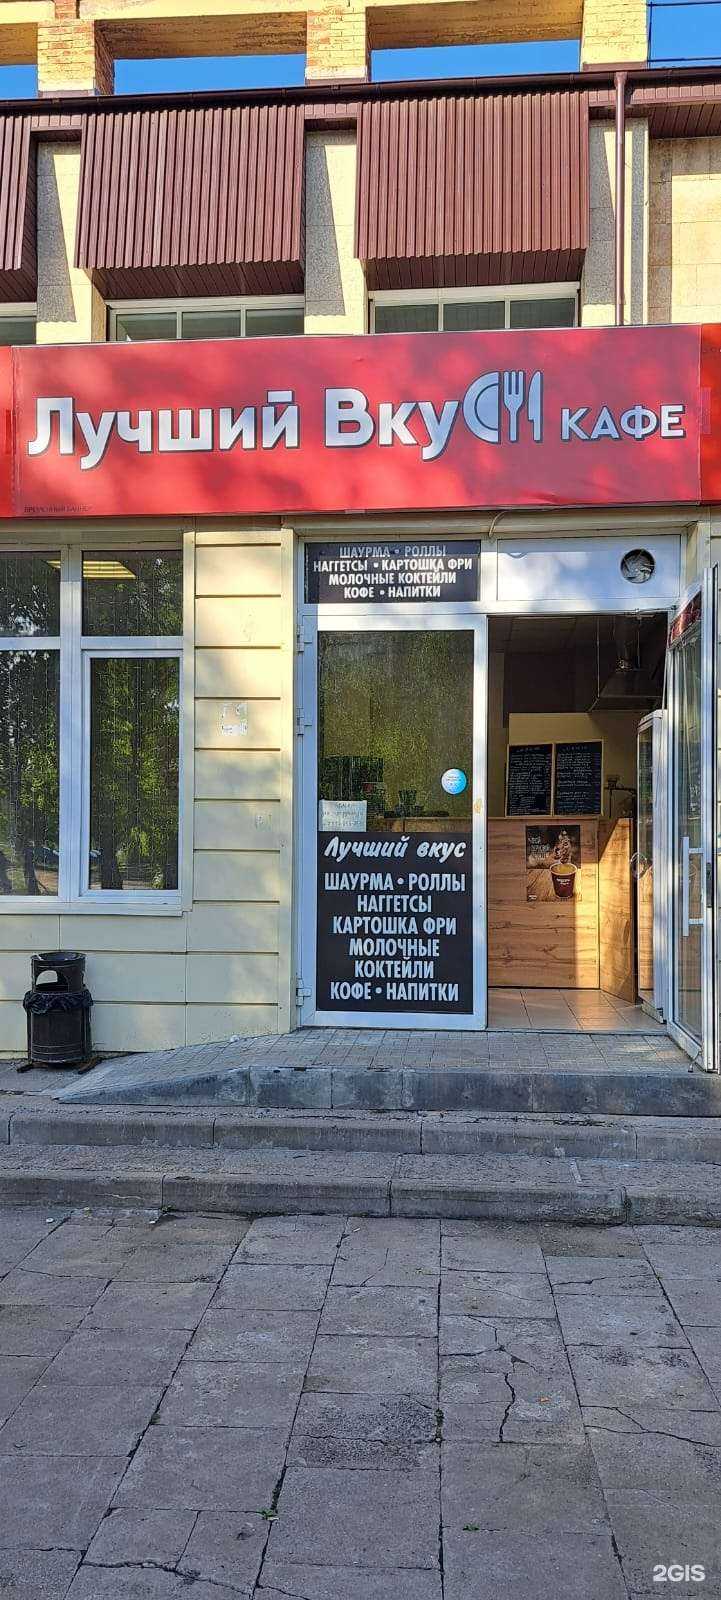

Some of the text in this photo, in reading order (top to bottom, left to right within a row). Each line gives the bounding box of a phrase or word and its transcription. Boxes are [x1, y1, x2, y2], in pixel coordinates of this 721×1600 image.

[27, 390, 301, 470] Лучший
[560, 403, 687, 442] КАФЕ
[339, 545, 446, 558] ШАУРМА РОЛЛЫ
[313, 558, 473, 572] НАГГЕТСЫ КАРТОШКА ФРИ
[328, 570, 457, 586] МОЛОЧНЫЕ КОКТЕЙЛИ
[344, 585, 441, 599] КОФЕ НАПИТКИ
[324, 835, 467, 863] Лучший вкус
[324, 873, 466, 892] ШАУРМА РОЛЛЫ
[357, 895, 432, 913] НАГГЕТСЫ
[332, 916, 457, 935] КАРТОШКА ФРИ
[349, 938, 440, 957] МОЛОЧНЫЕ
[354, 957, 435, 979] КОКТЕЙЛИ
[330, 981, 459, 1002] КОФЕ НАПИТКИ
